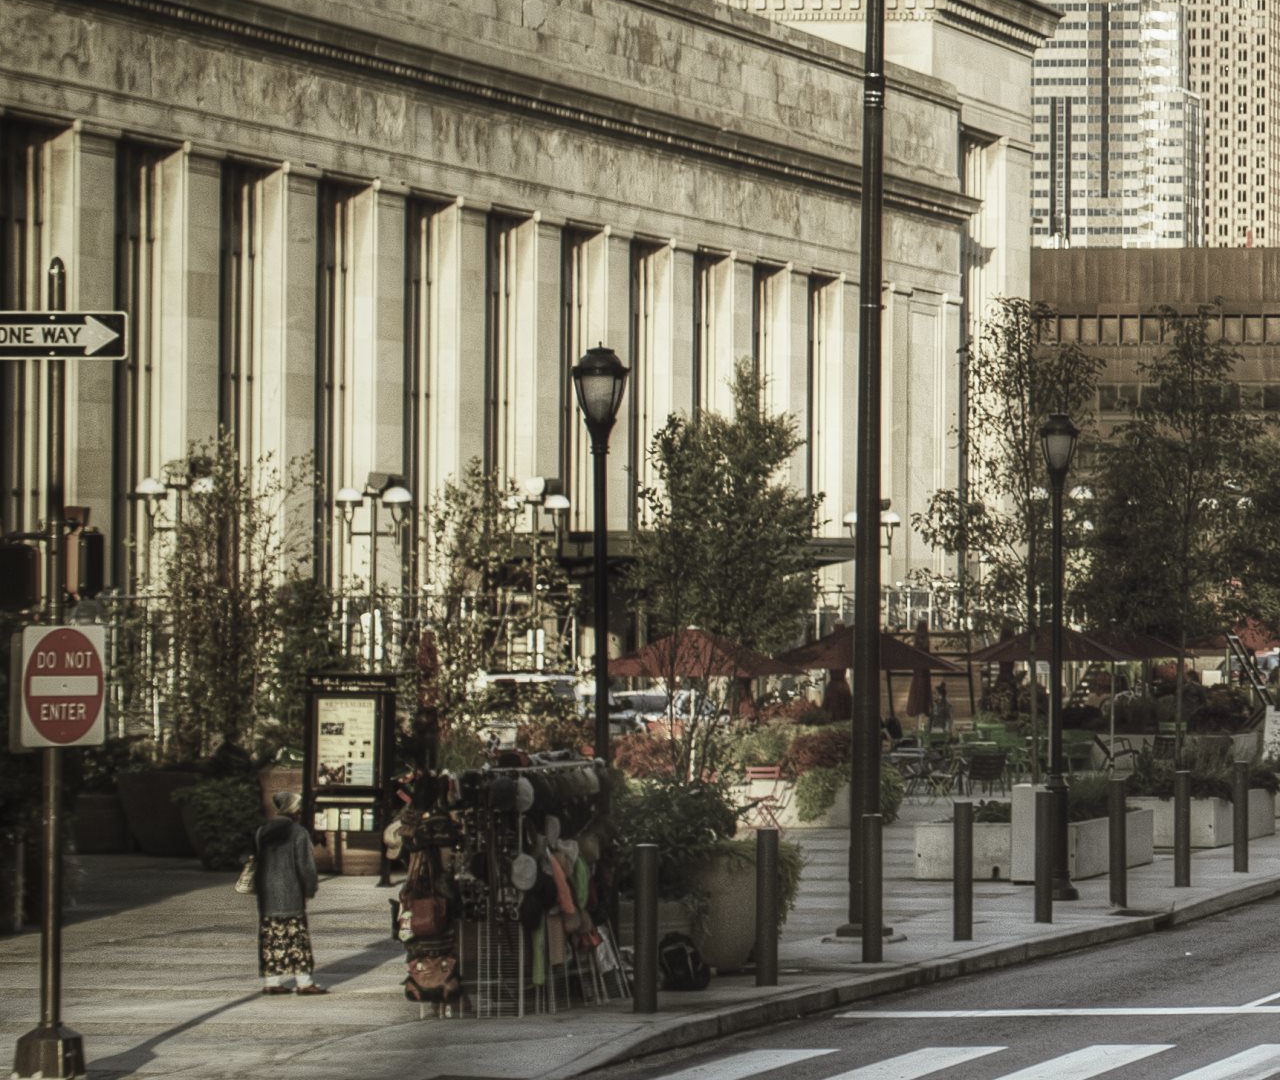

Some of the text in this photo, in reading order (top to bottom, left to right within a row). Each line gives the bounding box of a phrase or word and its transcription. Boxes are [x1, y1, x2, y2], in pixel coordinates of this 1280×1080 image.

[0, 327, 82, 344] ONE WAY
[37, 651, 93, 669] DO NOT
[40, 703, 86, 721] ENTER
